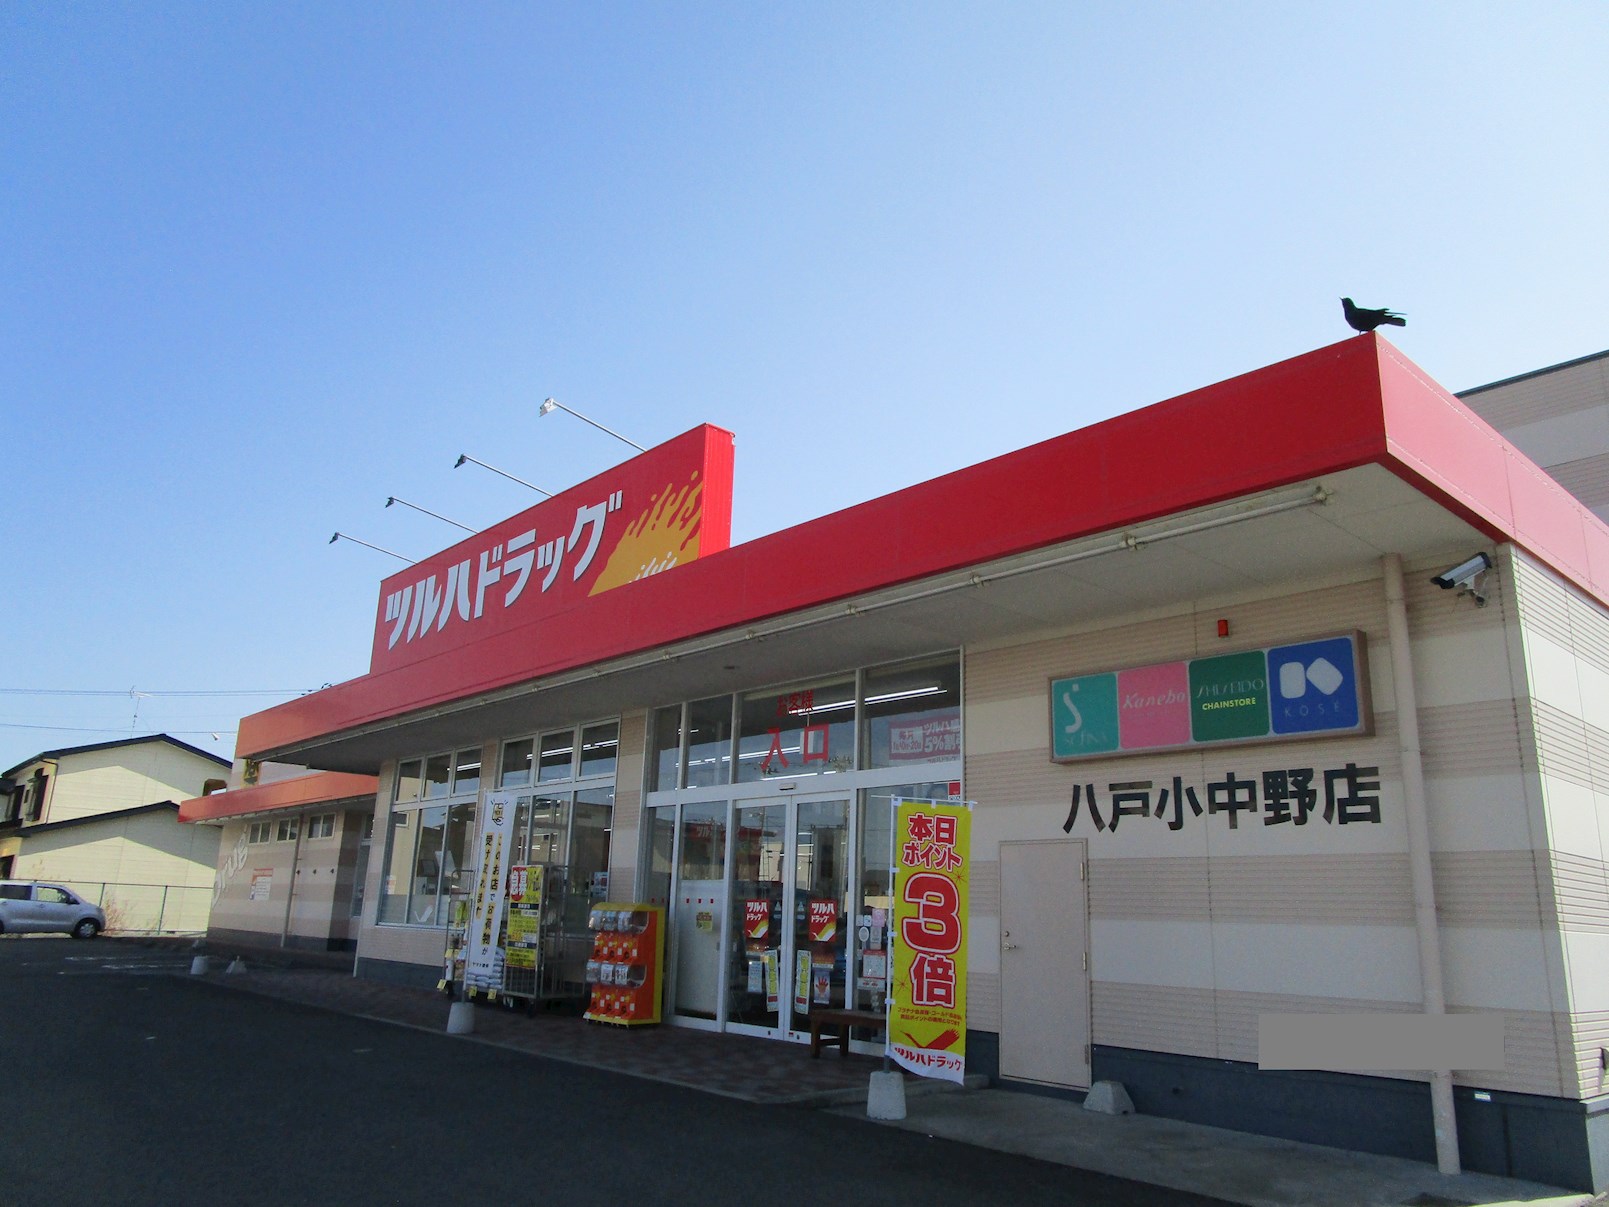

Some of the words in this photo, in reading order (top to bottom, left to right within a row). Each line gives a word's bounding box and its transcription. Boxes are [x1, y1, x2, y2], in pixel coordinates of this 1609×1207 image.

[385, 490, 622, 650] ツルハドラッグ
[1196, 678, 1264, 698] SHISEIDO
[1122, 690, 1186, 709] Kanebo
[1202, 697, 1256, 710] CHAINSTORE
[762, 724, 829, 771] 入口
[1062, 763, 1381, 833] 八戸小中野店
[907, 812, 957, 846] 本日
[902, 841, 963, 872] ポイント
[746, 902, 768, 913] ツルハ
[811, 903, 835, 914] ツルハ
[811, 915, 830, 923] ドラッグ
